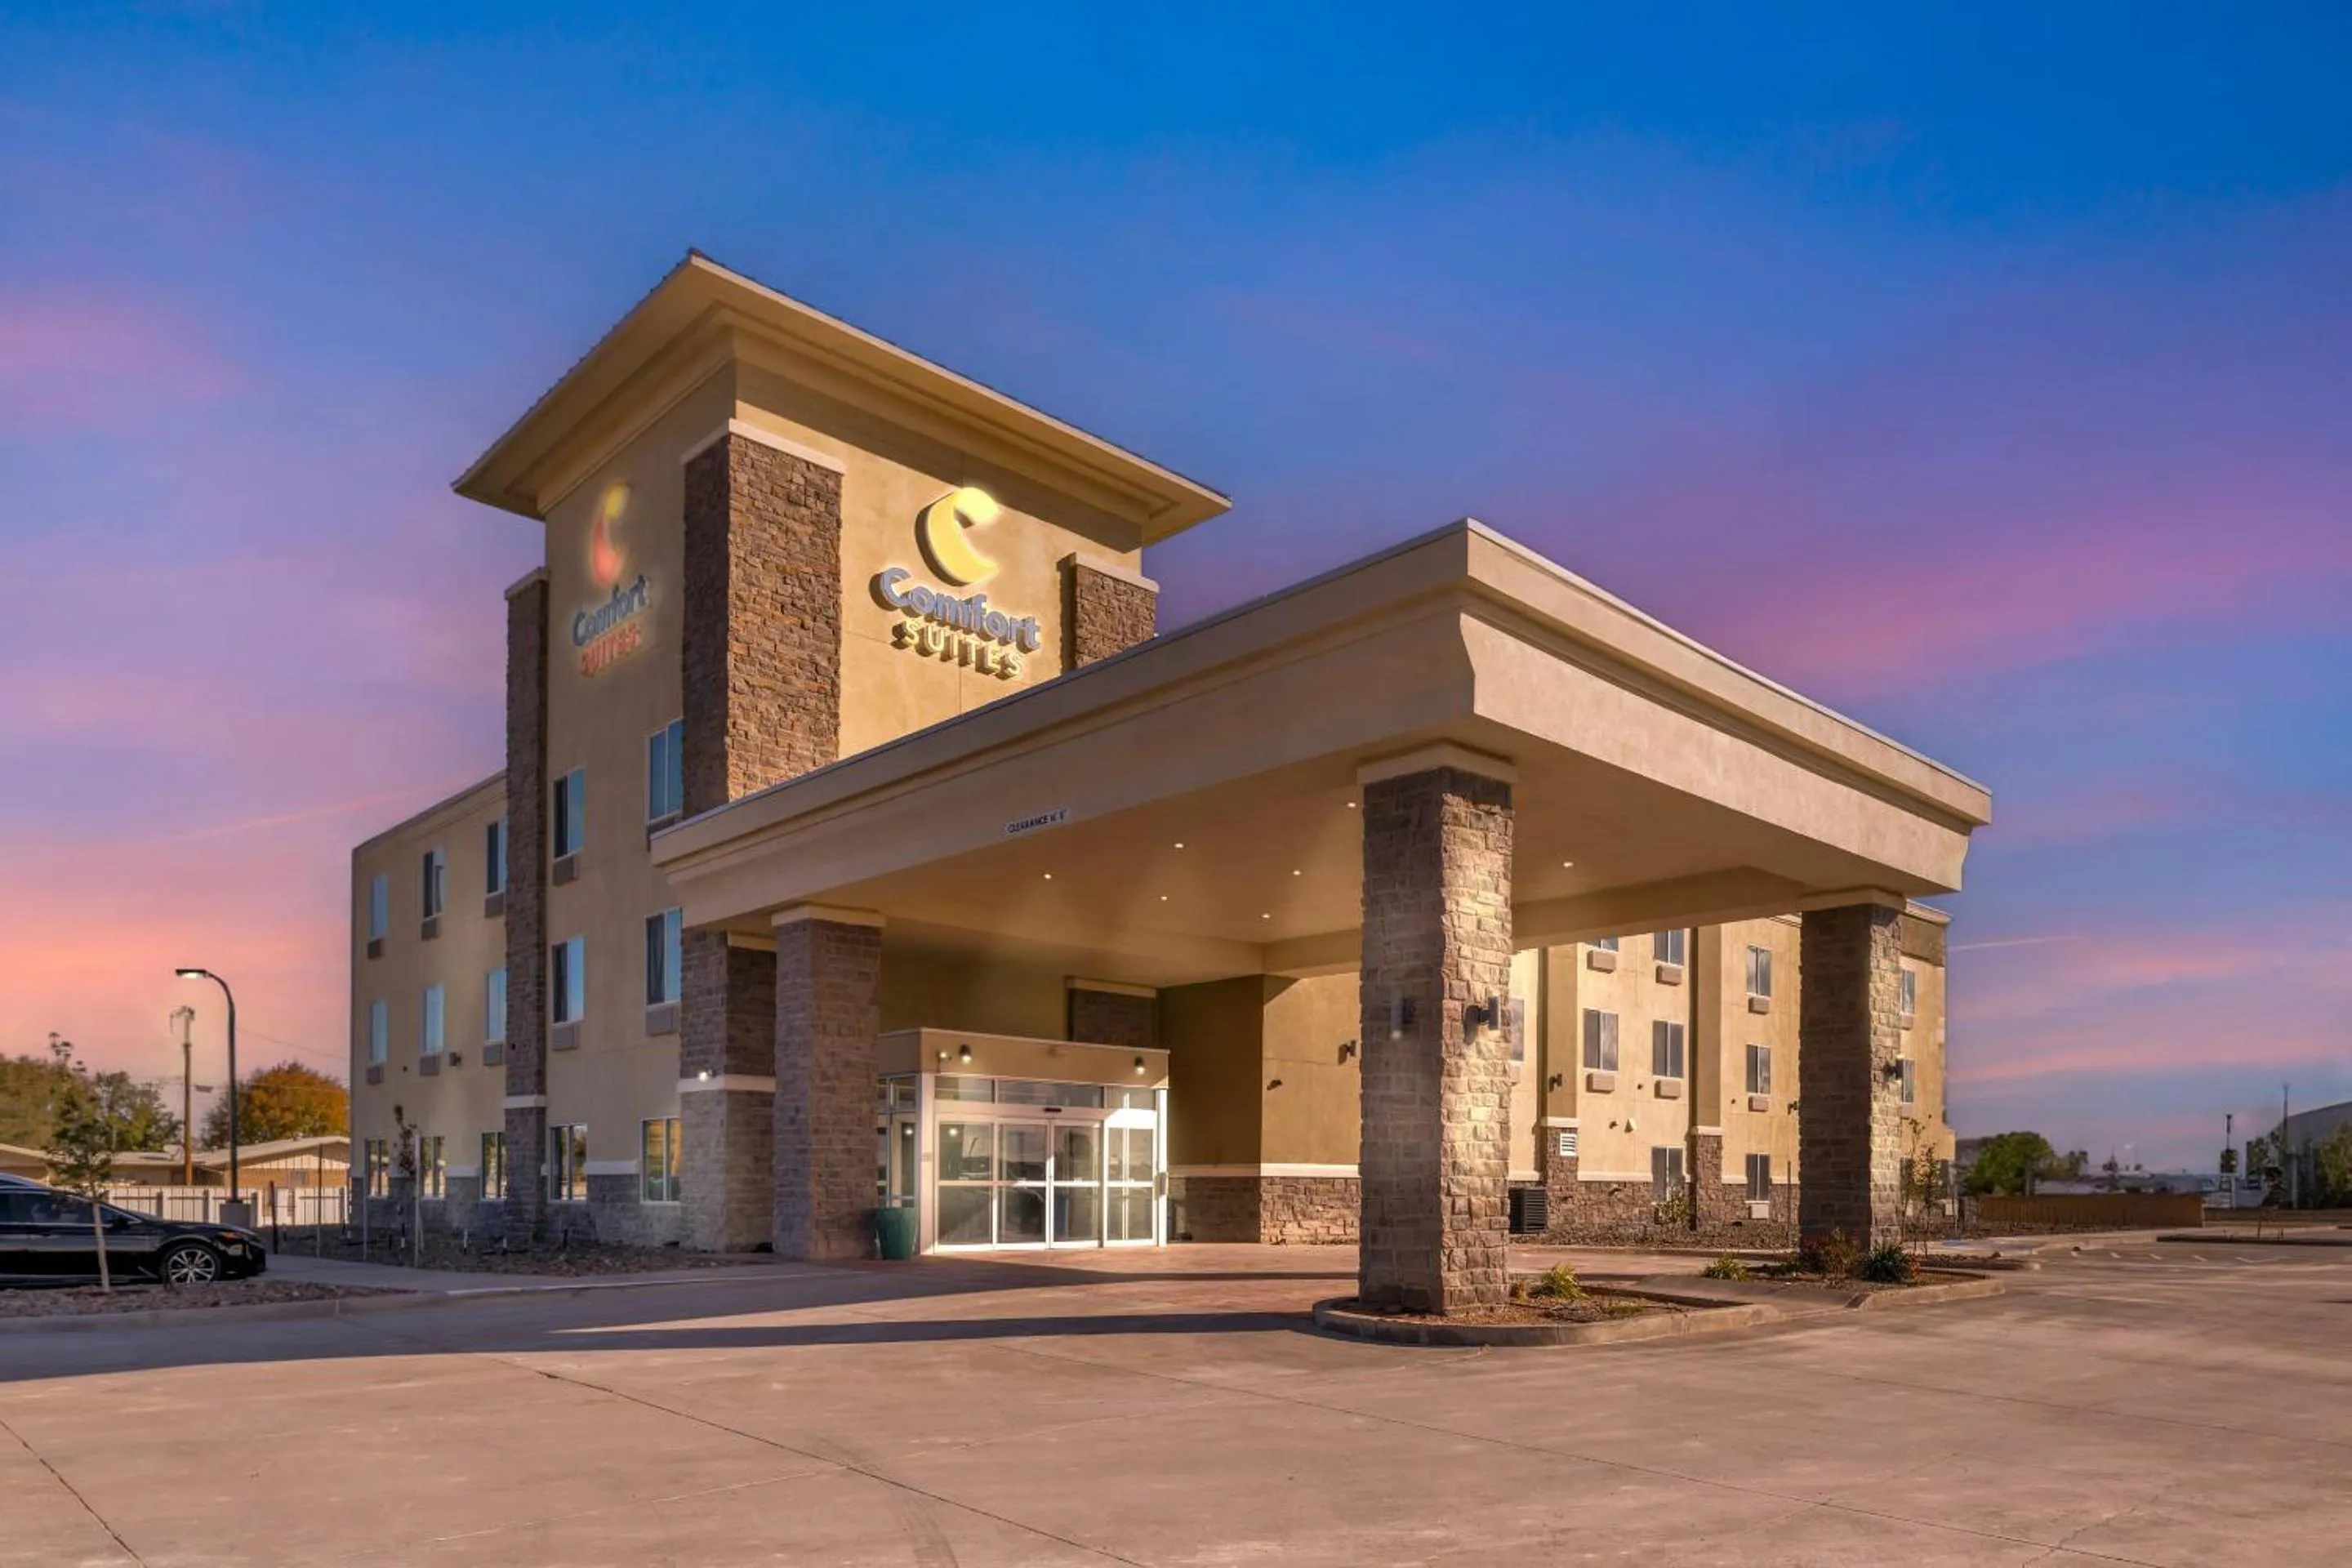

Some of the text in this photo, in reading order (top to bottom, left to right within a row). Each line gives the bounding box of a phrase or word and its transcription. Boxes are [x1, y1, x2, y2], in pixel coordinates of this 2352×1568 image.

[573, 573, 651, 646] Comfort
[879, 567, 1041, 650] Comfort
[894, 617, 1022, 679] SUITES
